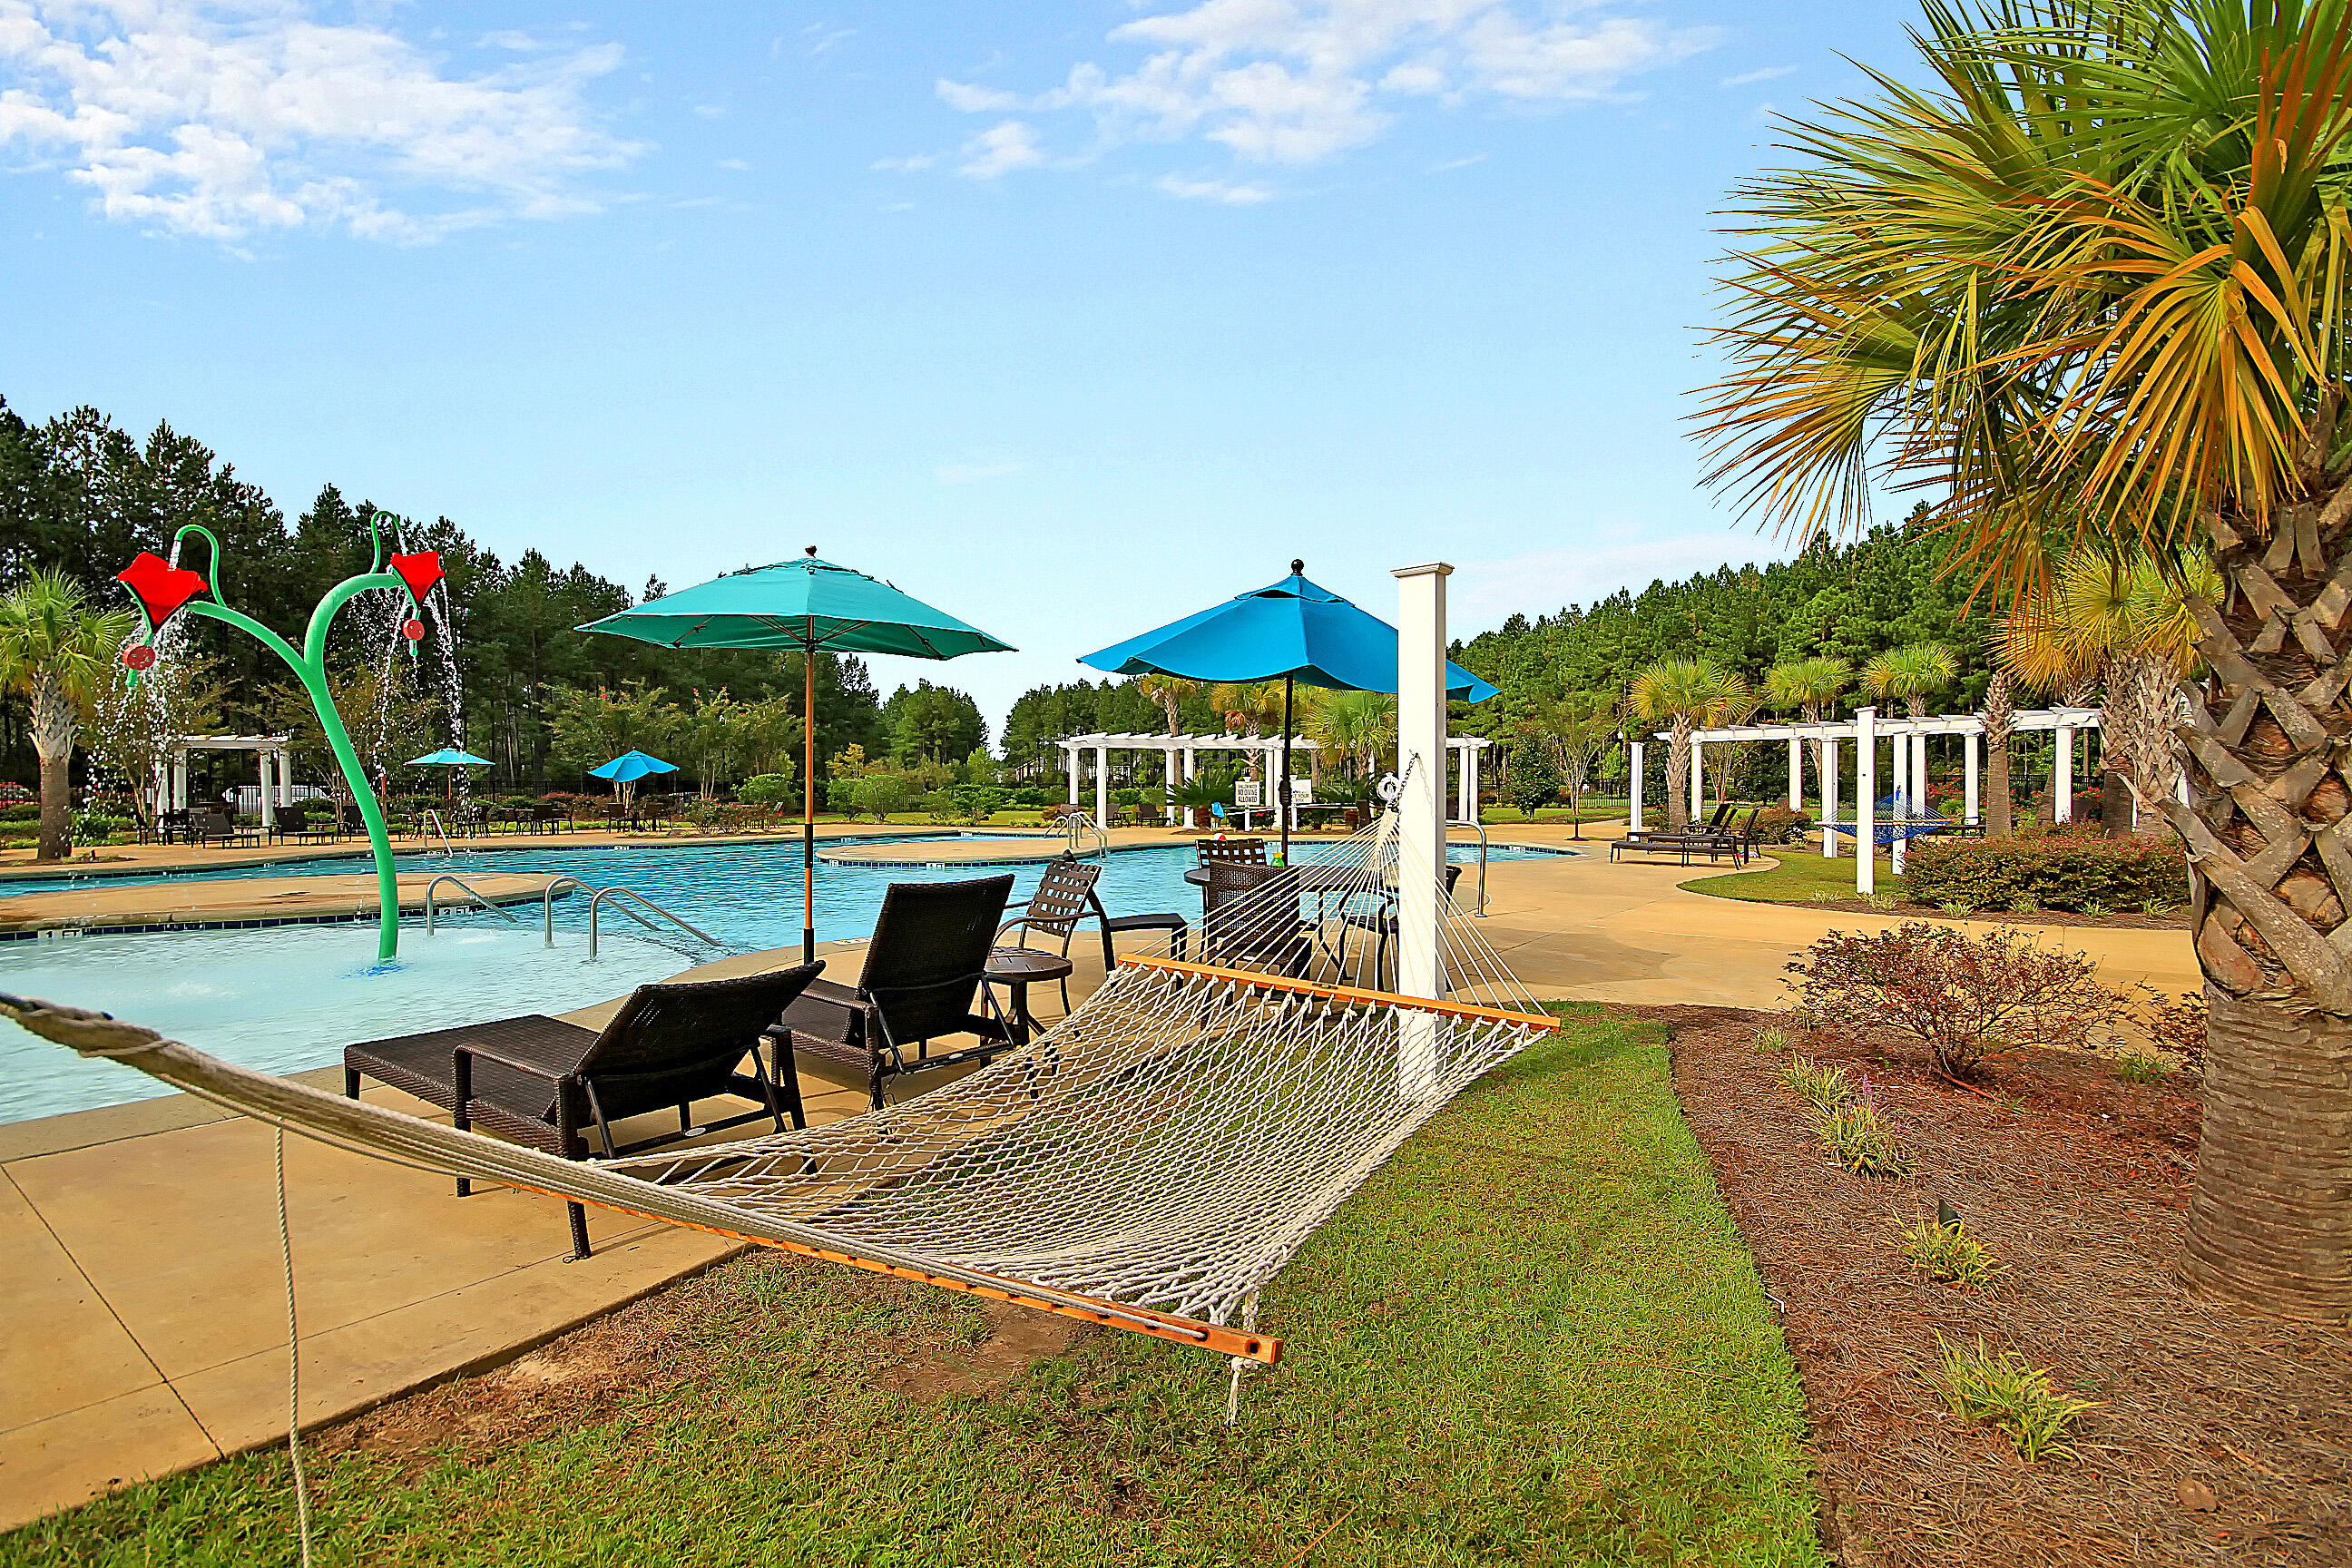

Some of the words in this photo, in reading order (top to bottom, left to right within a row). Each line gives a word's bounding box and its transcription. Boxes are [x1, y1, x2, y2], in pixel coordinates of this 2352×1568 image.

[456, 906, 468, 915] FT
[45, 930, 54, 938] 1
[62, 929, 81, 938] FT
